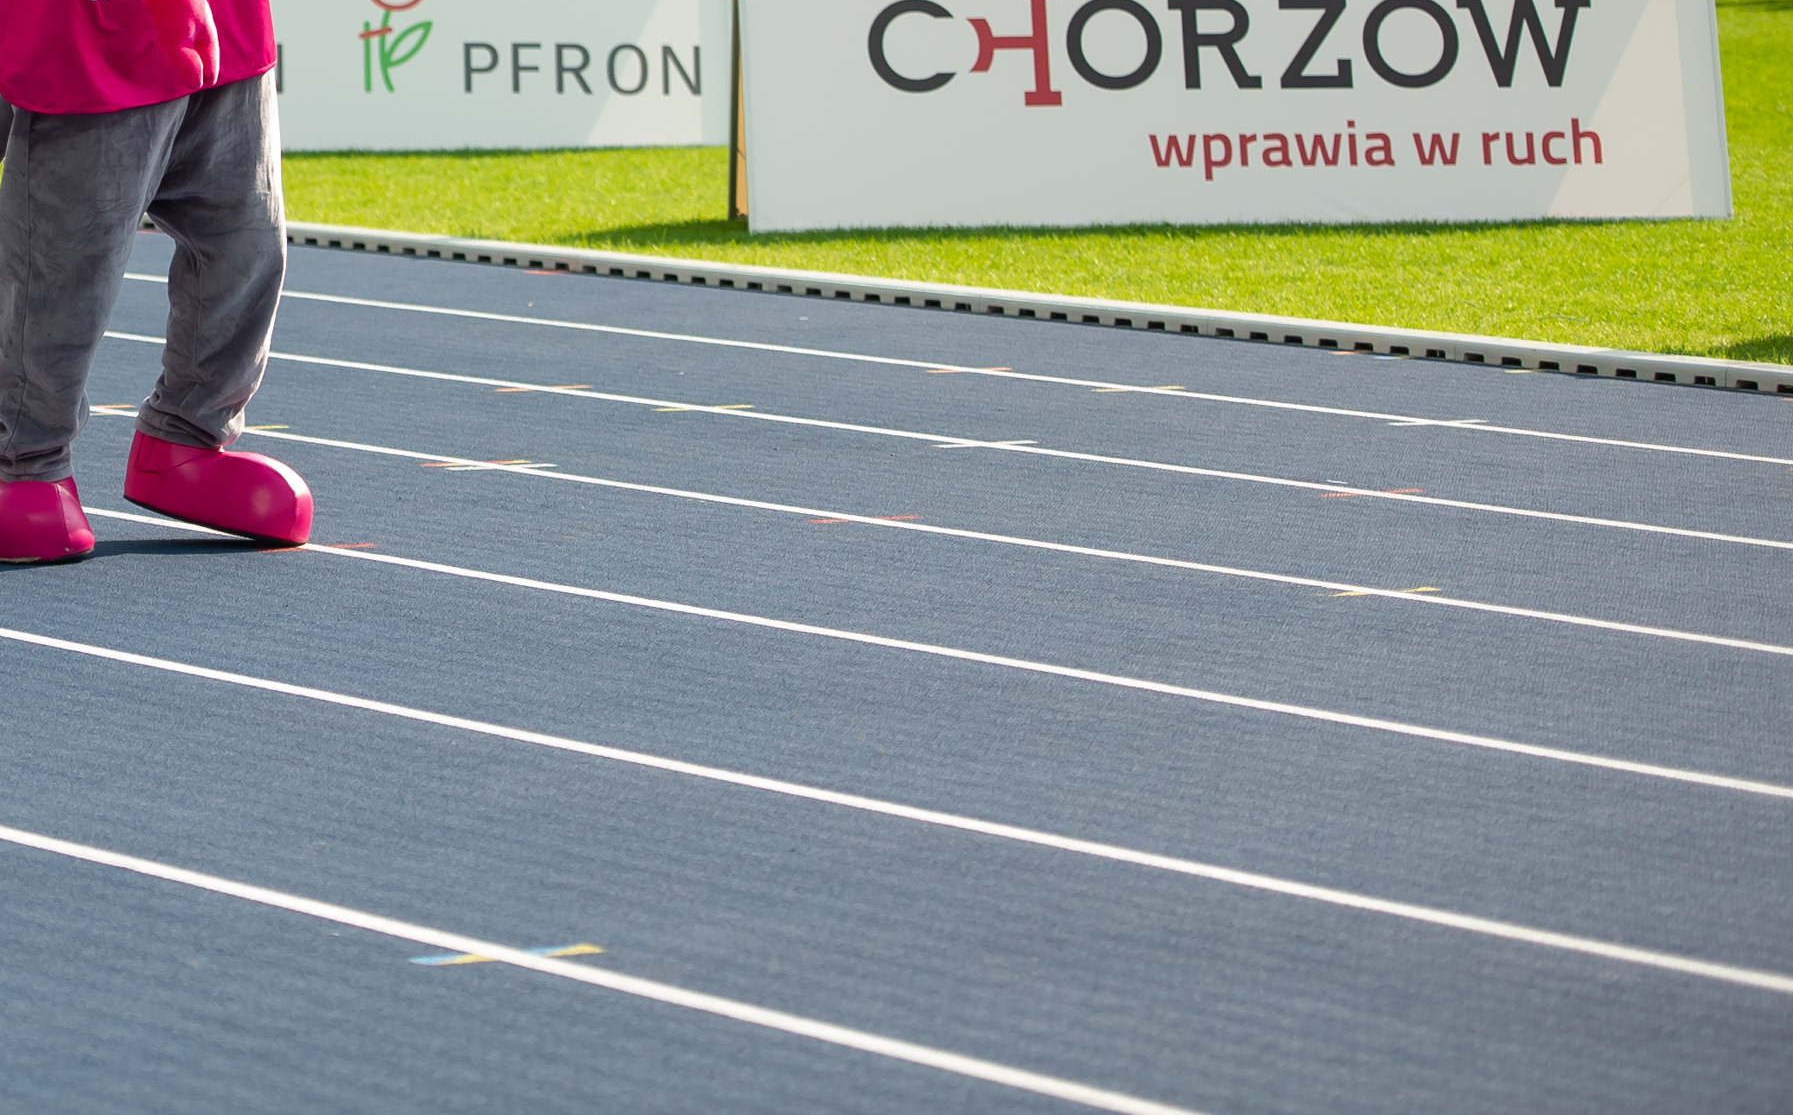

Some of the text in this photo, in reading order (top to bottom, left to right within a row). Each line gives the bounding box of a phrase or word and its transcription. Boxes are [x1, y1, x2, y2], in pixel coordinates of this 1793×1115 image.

[463, 42, 702, 96] PFRON
[1149, 118, 1603, 181] wprawia w ruch
